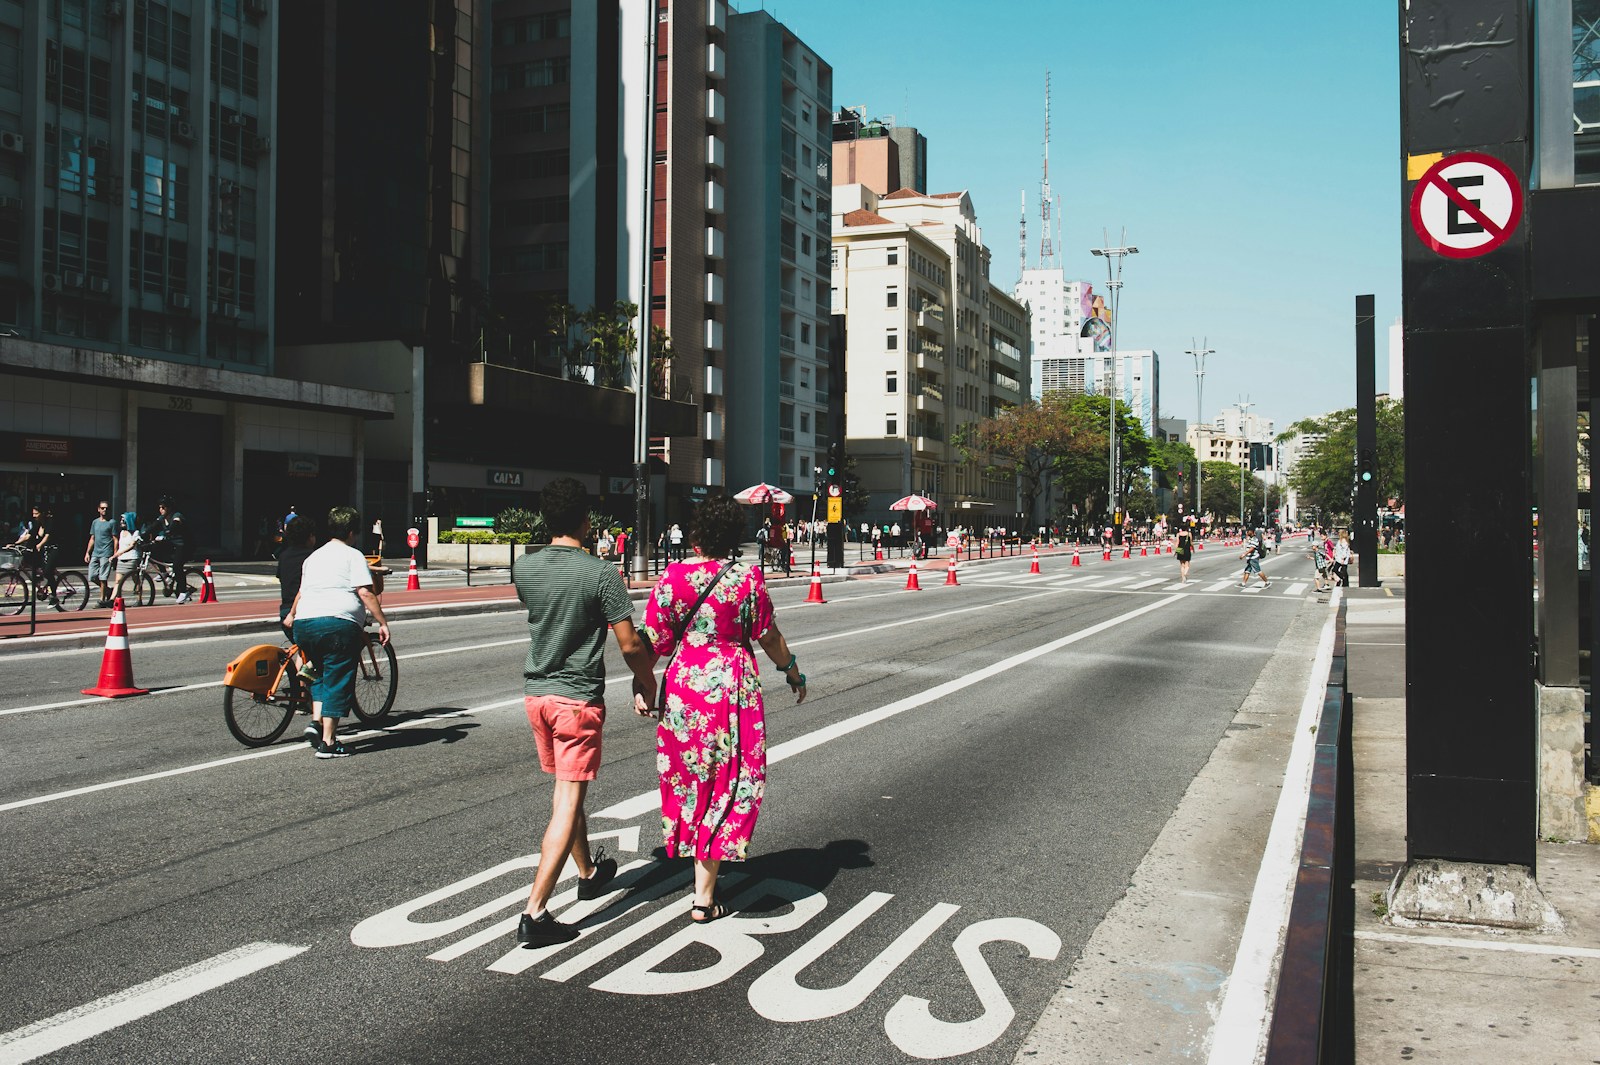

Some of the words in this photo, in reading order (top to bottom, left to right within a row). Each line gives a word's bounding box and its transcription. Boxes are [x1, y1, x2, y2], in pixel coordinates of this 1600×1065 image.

[1447, 175, 1485, 234] E
[26, 442, 68, 451] AMERICANAS
[494, 472, 521, 485] CAIXA
